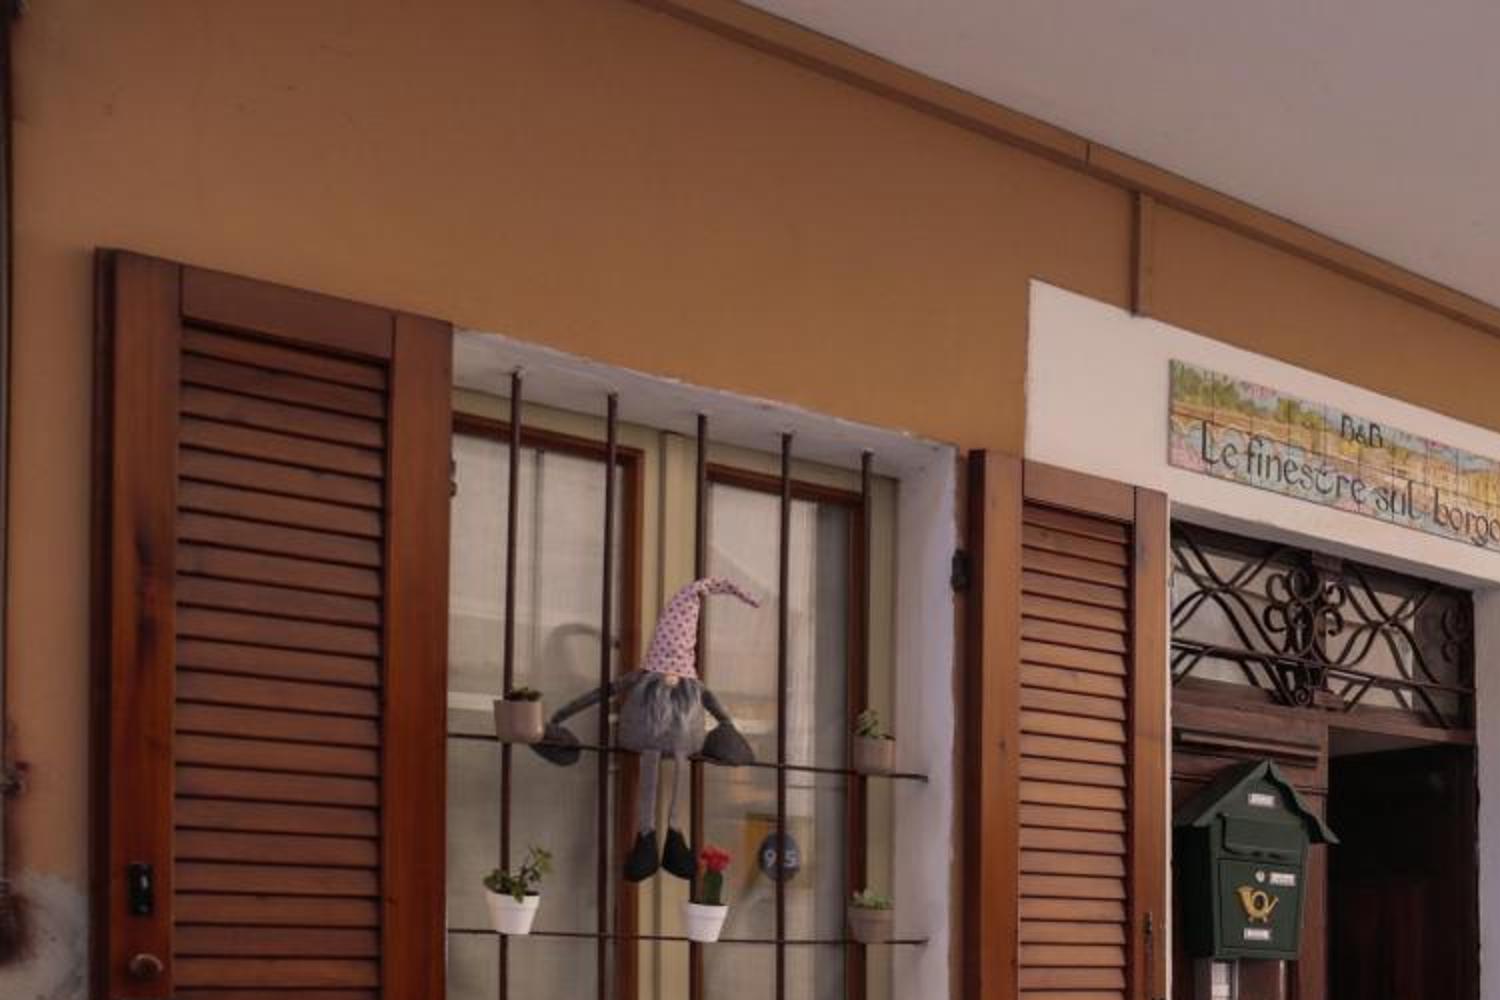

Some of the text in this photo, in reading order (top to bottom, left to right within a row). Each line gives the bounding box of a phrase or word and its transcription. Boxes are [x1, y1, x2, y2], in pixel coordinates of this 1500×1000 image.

[1341, 413, 1384, 449] B&B
[1201, 420, 1240, 470] Le
[1246, 434, 1367, 505] finestre
[1374, 480, 1422, 521] sul
